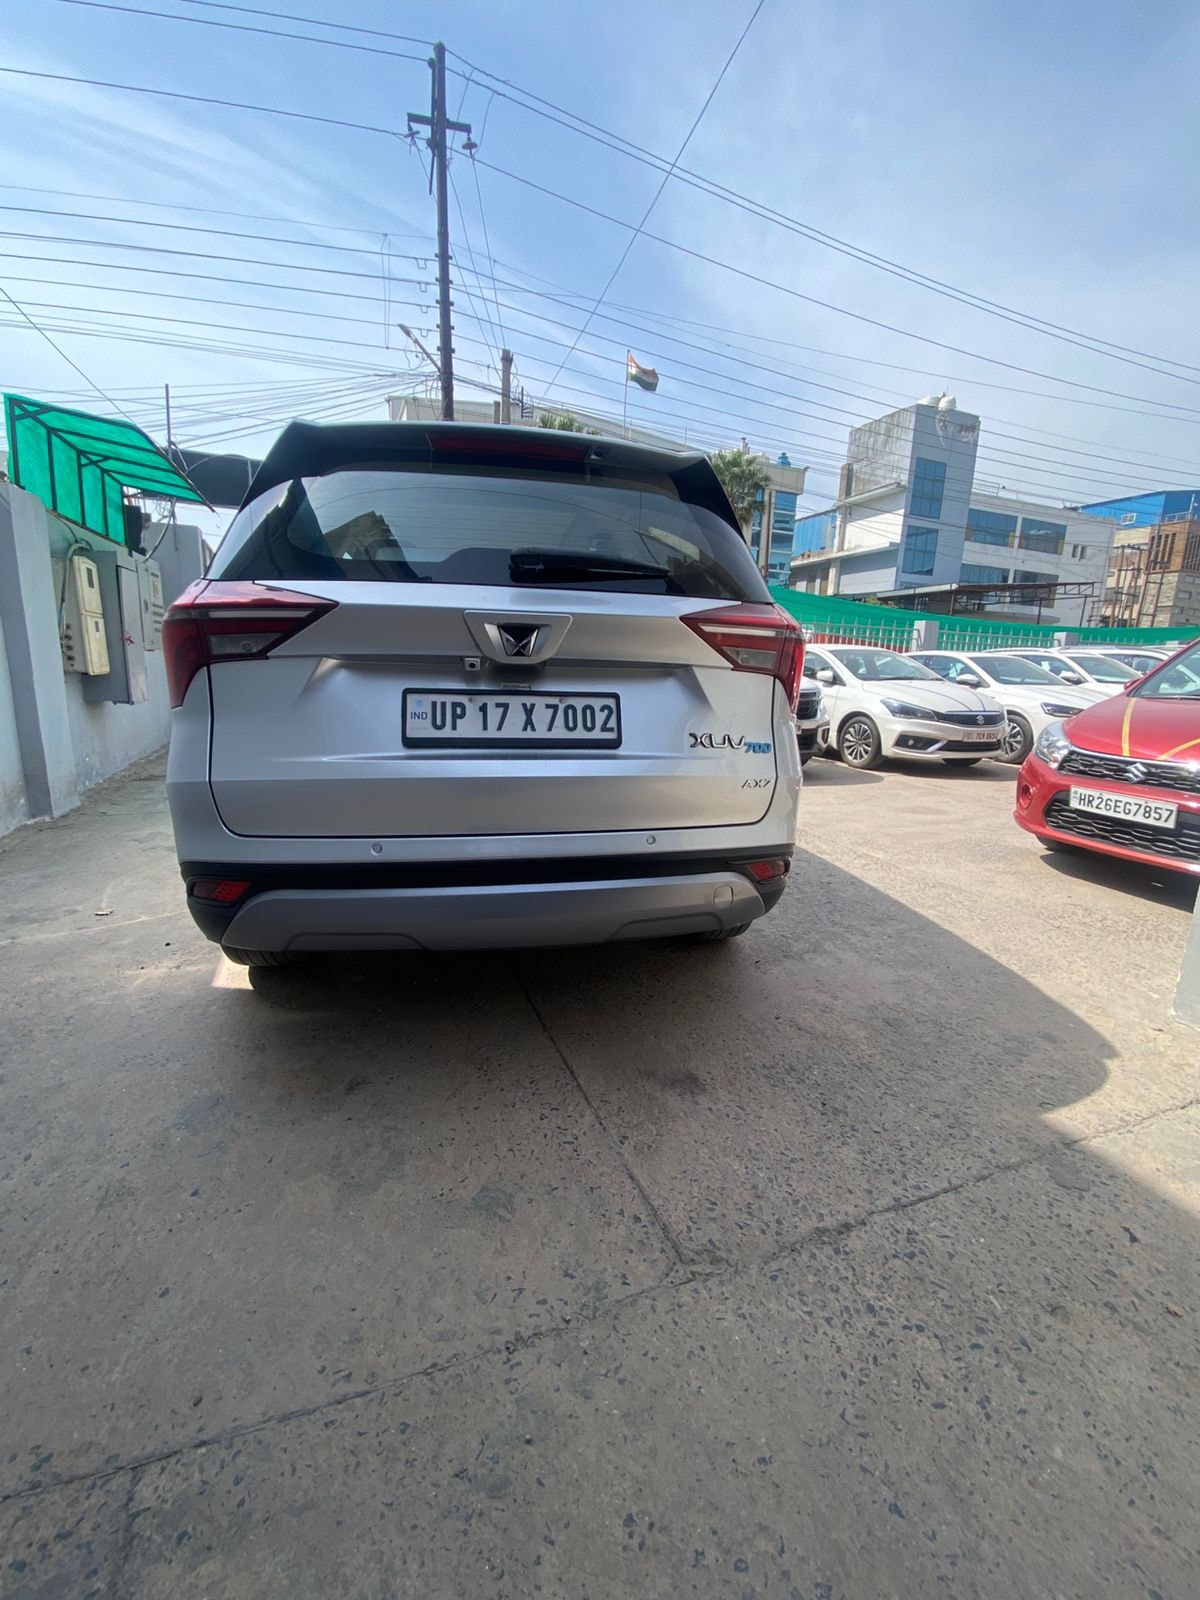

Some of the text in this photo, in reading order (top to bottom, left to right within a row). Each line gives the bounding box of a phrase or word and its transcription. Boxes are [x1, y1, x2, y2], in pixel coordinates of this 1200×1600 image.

[410, 711, 428, 720] IND
[431, 701, 615, 732] UP 17 X 7002
[1078, 792, 1174, 823] HR26EG7857
